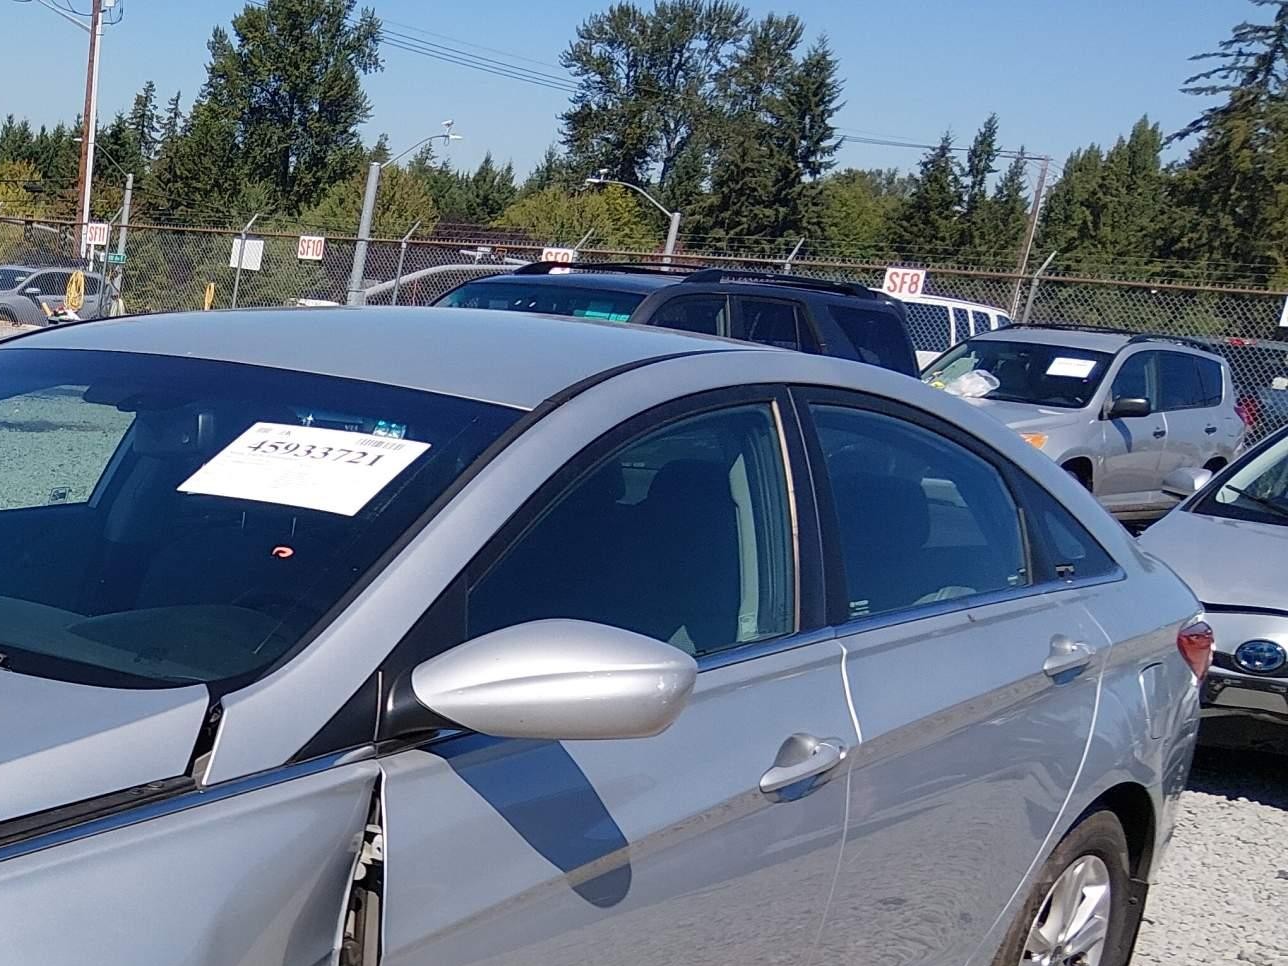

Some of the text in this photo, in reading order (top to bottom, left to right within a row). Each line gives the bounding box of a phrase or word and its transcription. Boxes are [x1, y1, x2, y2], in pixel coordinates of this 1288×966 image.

[89, 226, 106, 242] SF11
[300, 239, 323, 257] SF10
[887, 271, 920, 294] SF8
[248, 440, 384, 466] 45933721
